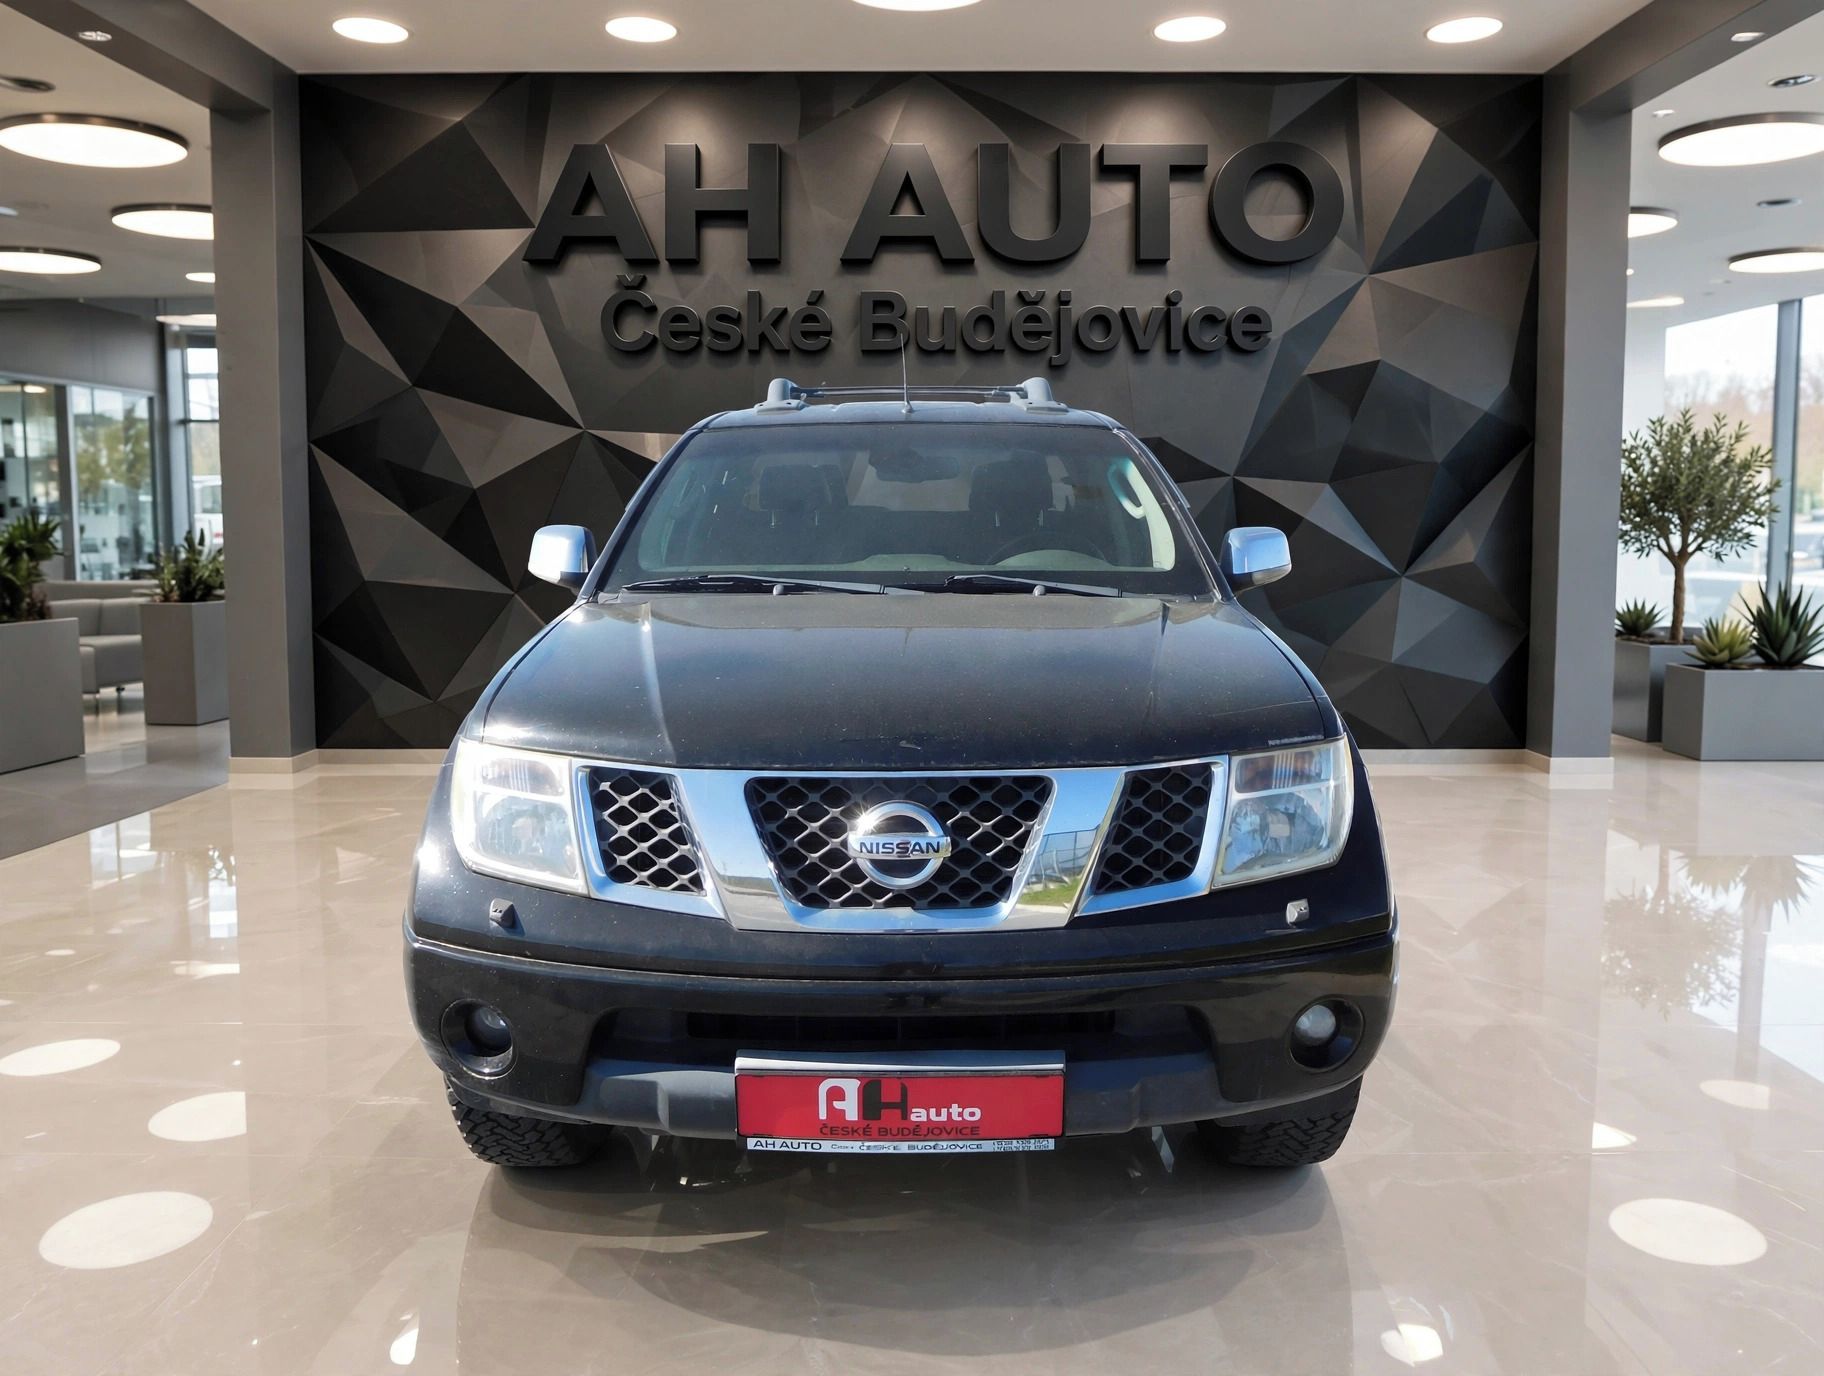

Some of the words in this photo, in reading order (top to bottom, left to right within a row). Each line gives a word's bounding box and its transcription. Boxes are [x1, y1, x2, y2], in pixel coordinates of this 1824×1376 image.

[523, 143, 782, 265] AH
[840, 141, 1346, 267] AUTO
[600, 274, 834, 353] České
[860, 289, 1274, 367] Budějovice
[859, 840, 940, 857] NISSAN
[819, 1123, 873, 1137] ČESKÉ
[753, 1139, 776, 1149] AH
[779, 1140, 822, 1151] AUTO
